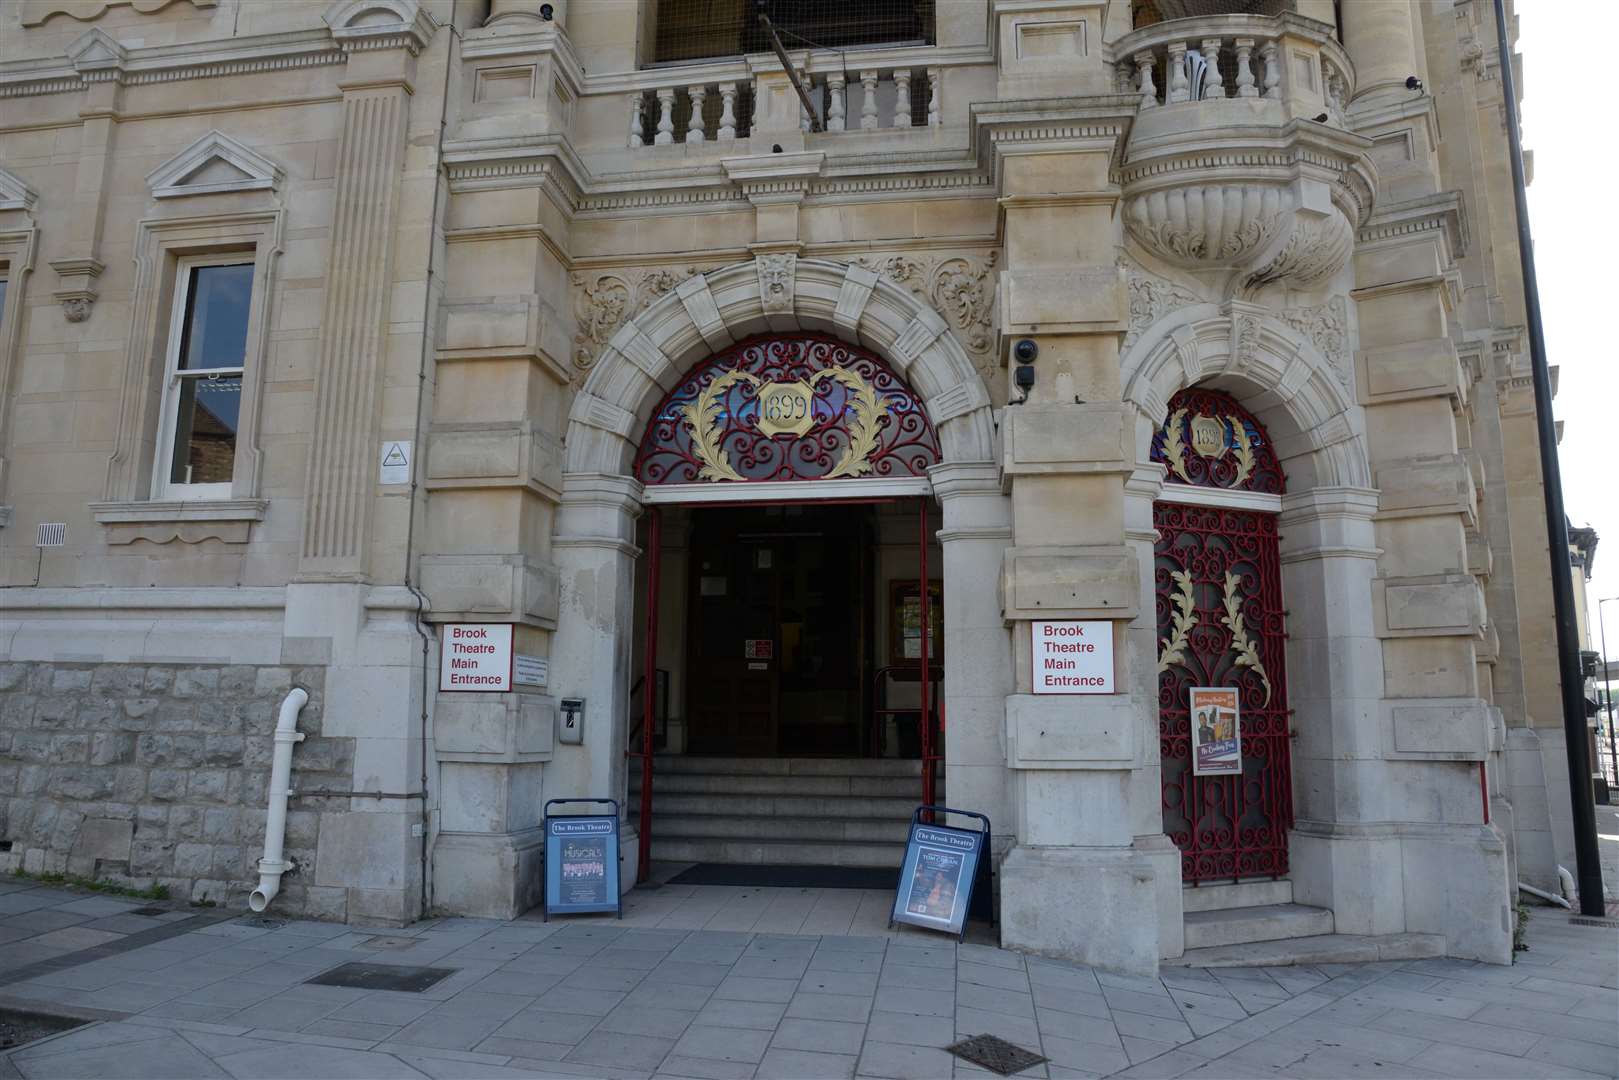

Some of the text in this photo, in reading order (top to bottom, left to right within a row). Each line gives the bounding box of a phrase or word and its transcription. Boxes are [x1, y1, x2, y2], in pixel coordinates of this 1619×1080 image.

[765, 395, 807, 420] 1899
[453, 627, 487, 638] Brook
[1044, 625, 1084, 636] Brook
[452, 643, 495, 653] Theatre
[1044, 641, 1095, 653] Theatre
[451, 658, 478, 669] Main
[1044, 658, 1076, 670] Main
[451, 673, 502, 684] Entrance
[1045, 674, 1105, 686] Entrance
[918, 831, 973, 847] The Brook Theatre
